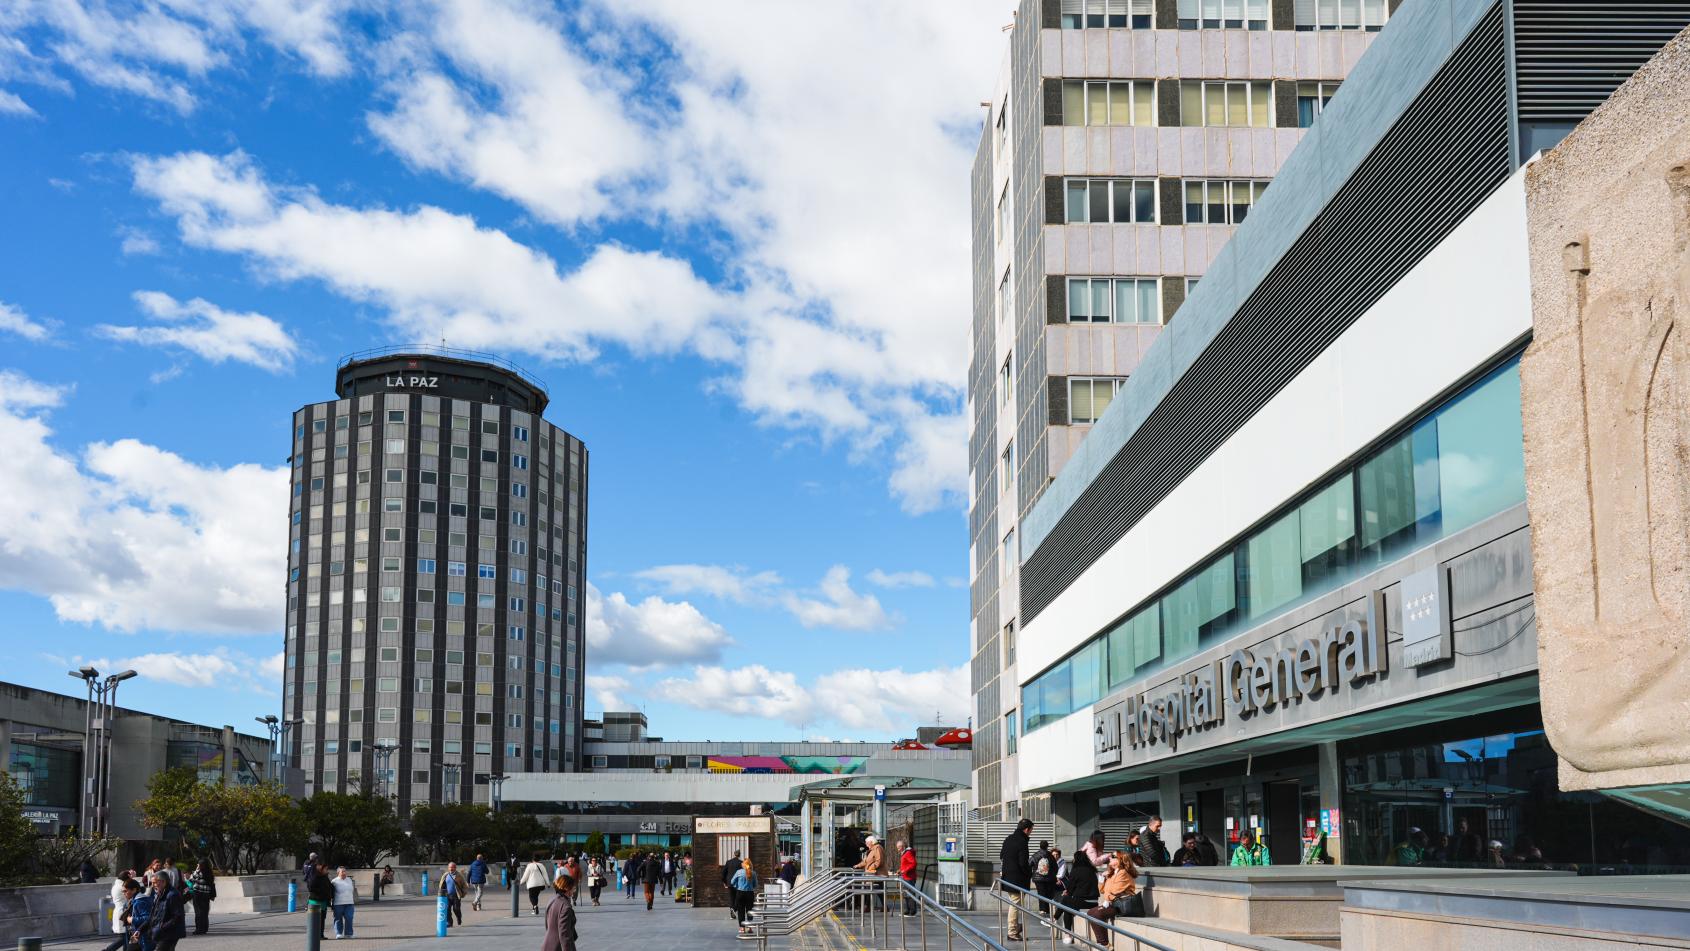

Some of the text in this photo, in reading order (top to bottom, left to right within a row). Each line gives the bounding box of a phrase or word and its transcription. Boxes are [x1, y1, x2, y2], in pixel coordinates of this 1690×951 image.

[386, 376, 438, 388] LA PAZ
[1122, 660, 1222, 749] Hospital
[1229, 589, 1388, 715] General
